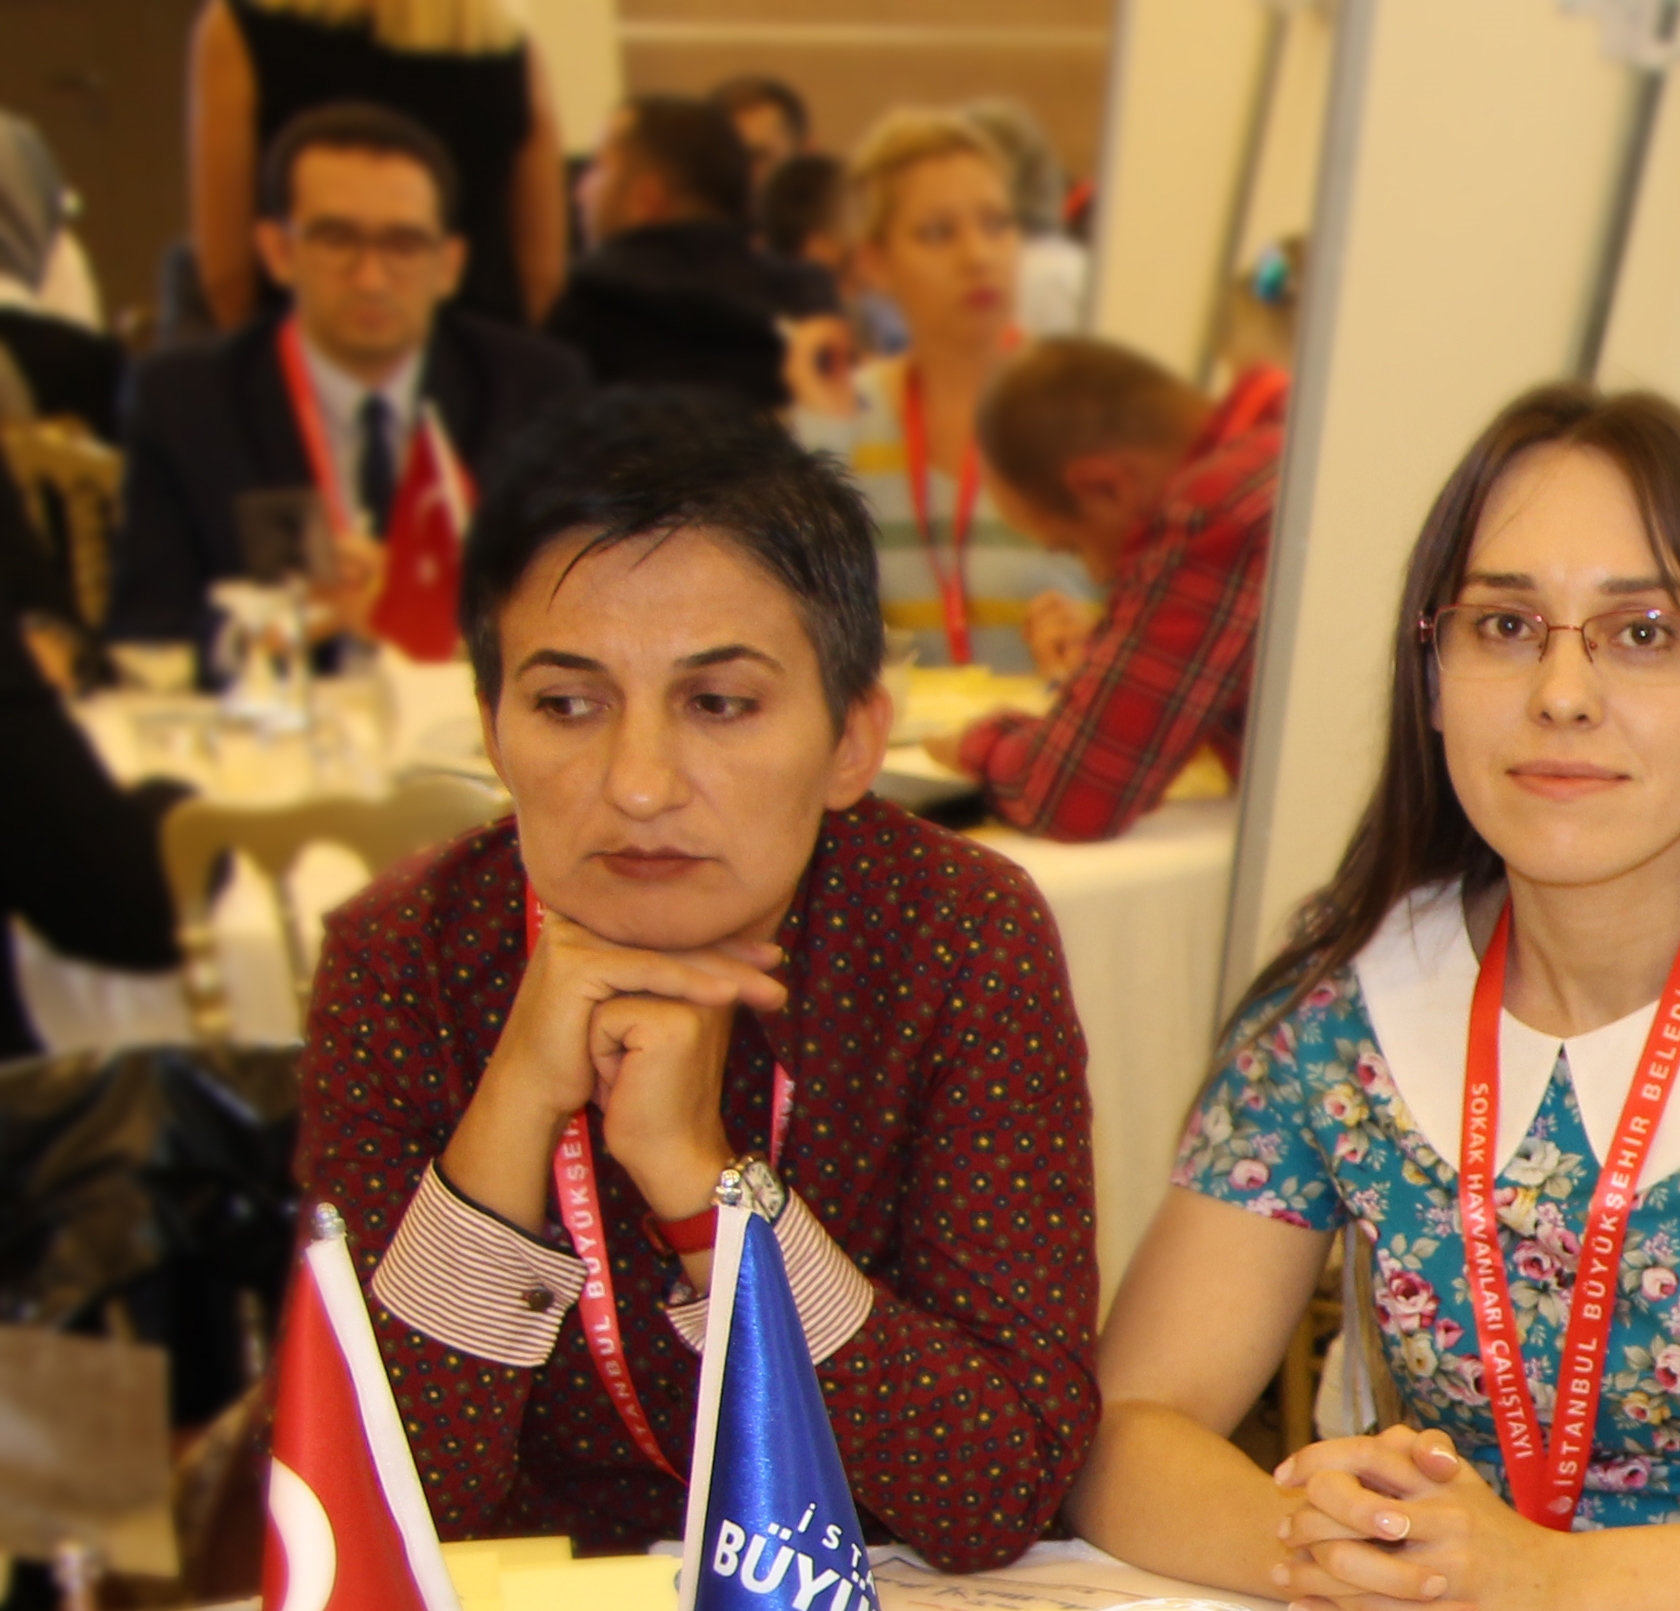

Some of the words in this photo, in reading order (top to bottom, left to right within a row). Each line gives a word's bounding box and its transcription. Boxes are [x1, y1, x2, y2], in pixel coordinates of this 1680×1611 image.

[1470, 1082, 1489, 1168] SOKAK
[1467, 1173, 1504, 1326] HAYVANLARI
[1556, 1351, 1596, 1487] İSTANBUL
[1583, 1114, 1652, 1323] BÜYÜKŞEHİR
[1490, 1341, 1535, 1461] ÇALIŞTAYI
